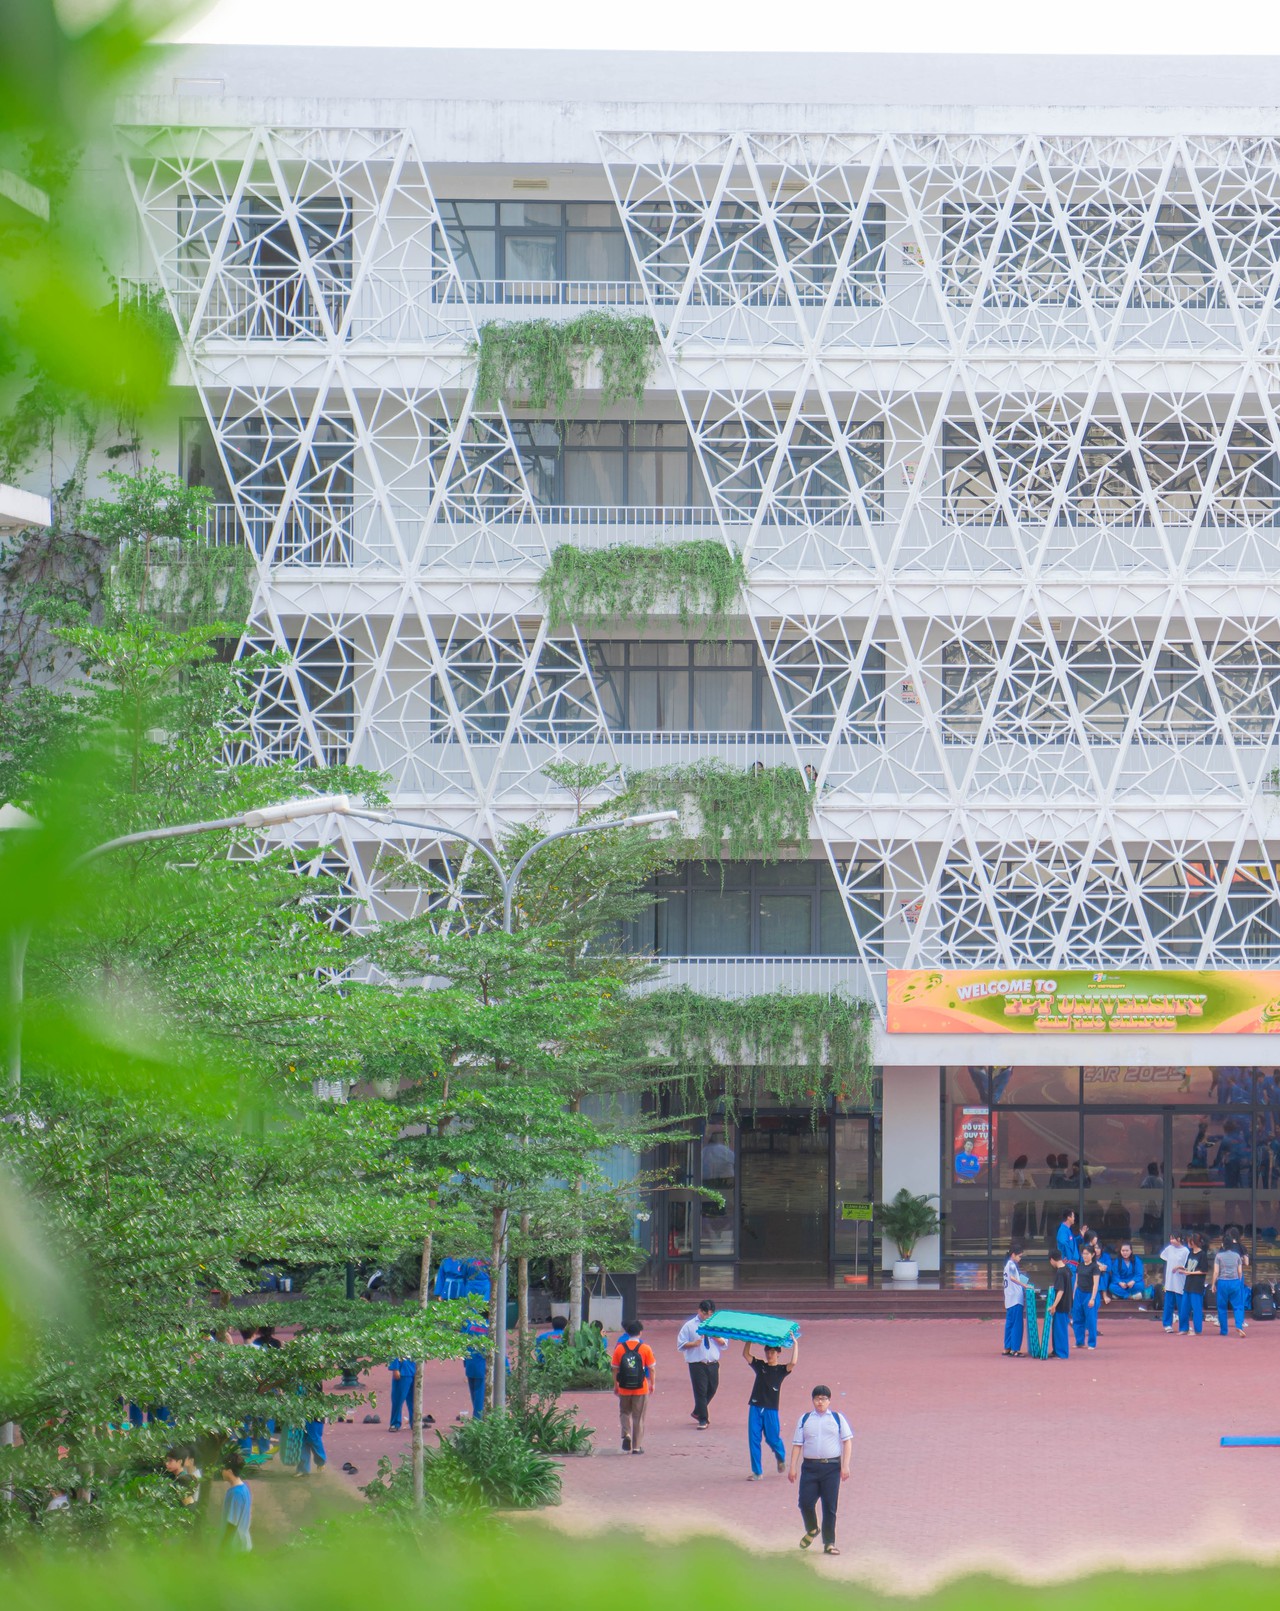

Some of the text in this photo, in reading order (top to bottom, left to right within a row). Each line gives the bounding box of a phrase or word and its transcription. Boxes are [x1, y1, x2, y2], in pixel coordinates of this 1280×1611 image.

[957, 979, 1057, 1000] WELCOME TO
[1004, 995, 1207, 1015] FPT UNIVERSITY
[1109, 1015, 1176, 1029] CAMPUS
